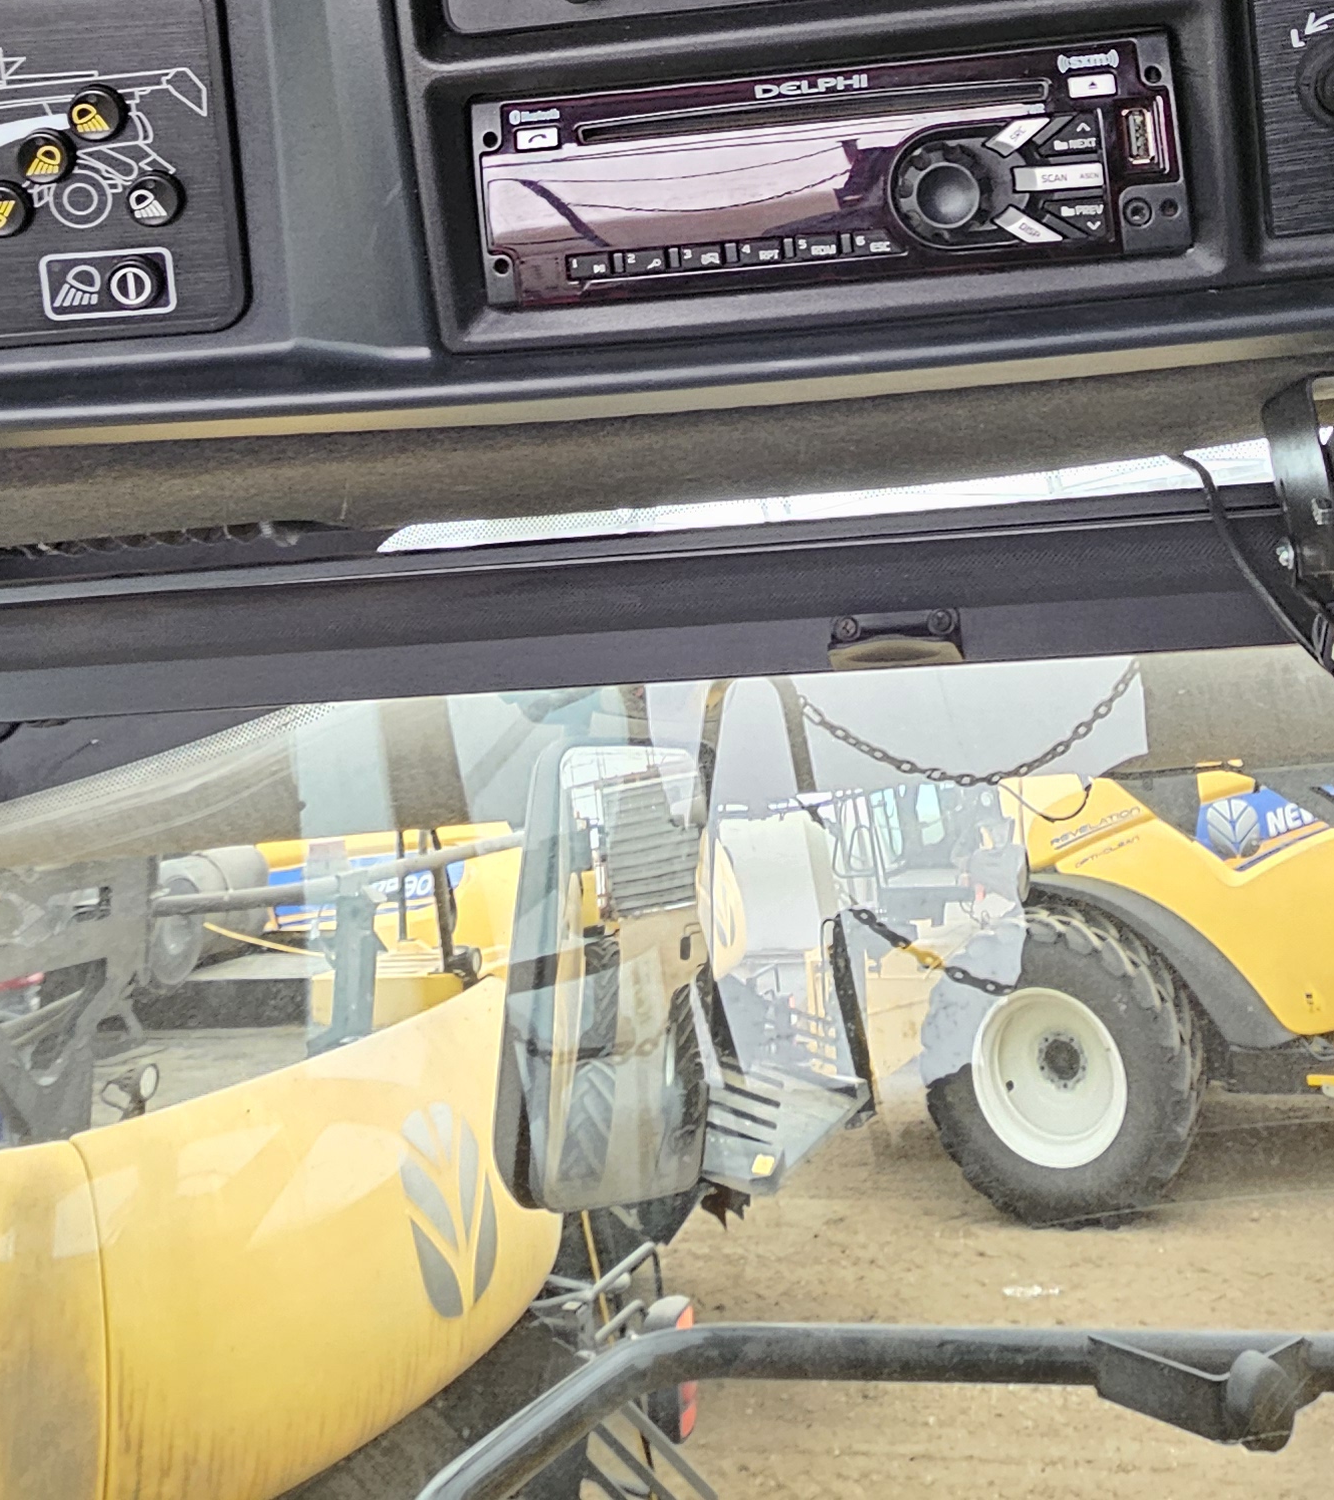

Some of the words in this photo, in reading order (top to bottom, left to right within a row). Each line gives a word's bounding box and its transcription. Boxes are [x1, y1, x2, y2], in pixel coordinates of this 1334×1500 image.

[1290, 28, 1306, 48] L
[753, 73, 869, 99] DELPHI
[1009, 125, 1028, 142] SRC
[1068, 137, 1097, 149] NEXT
[1041, 174, 1068, 183] SCAN
[1075, 204, 1104, 215] PREV
[1018, 222, 1041, 239] DISP
[741, 244, 751, 254] 4
[758, 249, 779, 261] RPT
[798, 239, 807, 249] 5
[855, 235, 865, 246] 6
[869, 241, 891, 253] ESC
[627, 254, 636, 264] 2
[683, 249, 692, 259] 3
[1050, 806, 1141, 846] REVELATION
